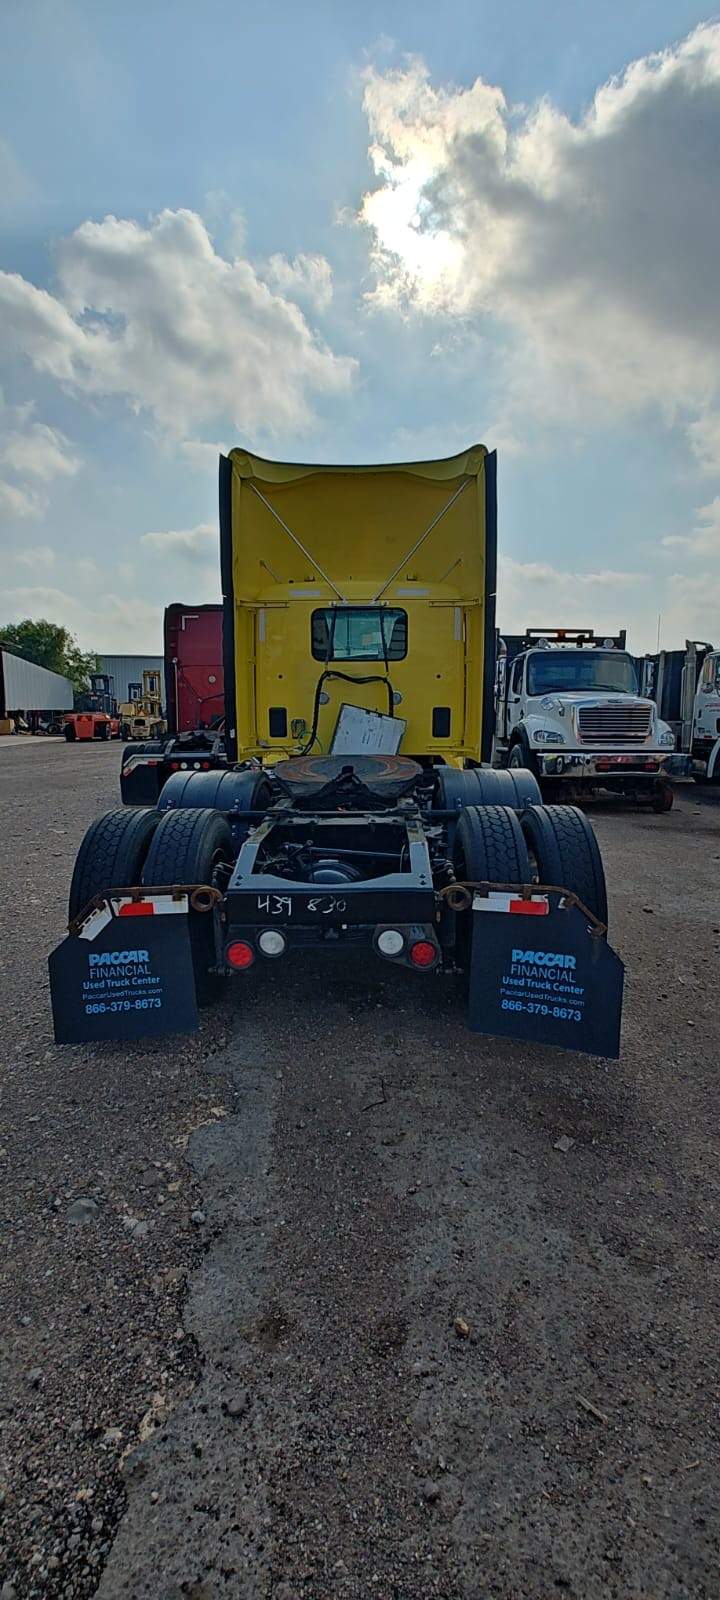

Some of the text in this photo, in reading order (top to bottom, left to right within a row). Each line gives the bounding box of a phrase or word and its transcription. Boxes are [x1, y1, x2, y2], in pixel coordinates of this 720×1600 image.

[257, 895, 346, 916] 439 830
[88, 949, 150, 967] PACCAR
[511, 949, 577, 969] PACCAR
[89, 964, 152, 979] FINANCIAL
[510, 964, 577, 983] FINANCIAL
[83, 976, 161, 990] Used Truck Center
[502, 975, 585, 995] Used Truck Center
[82, 987, 163, 1001] PaccarUsedTrucks.com
[500, 988, 585, 1007] PaccarUsedTrucks.com
[85, 998, 162, 1015] 866-379-8673
[501, 999, 582, 1022] 866-379-8673
